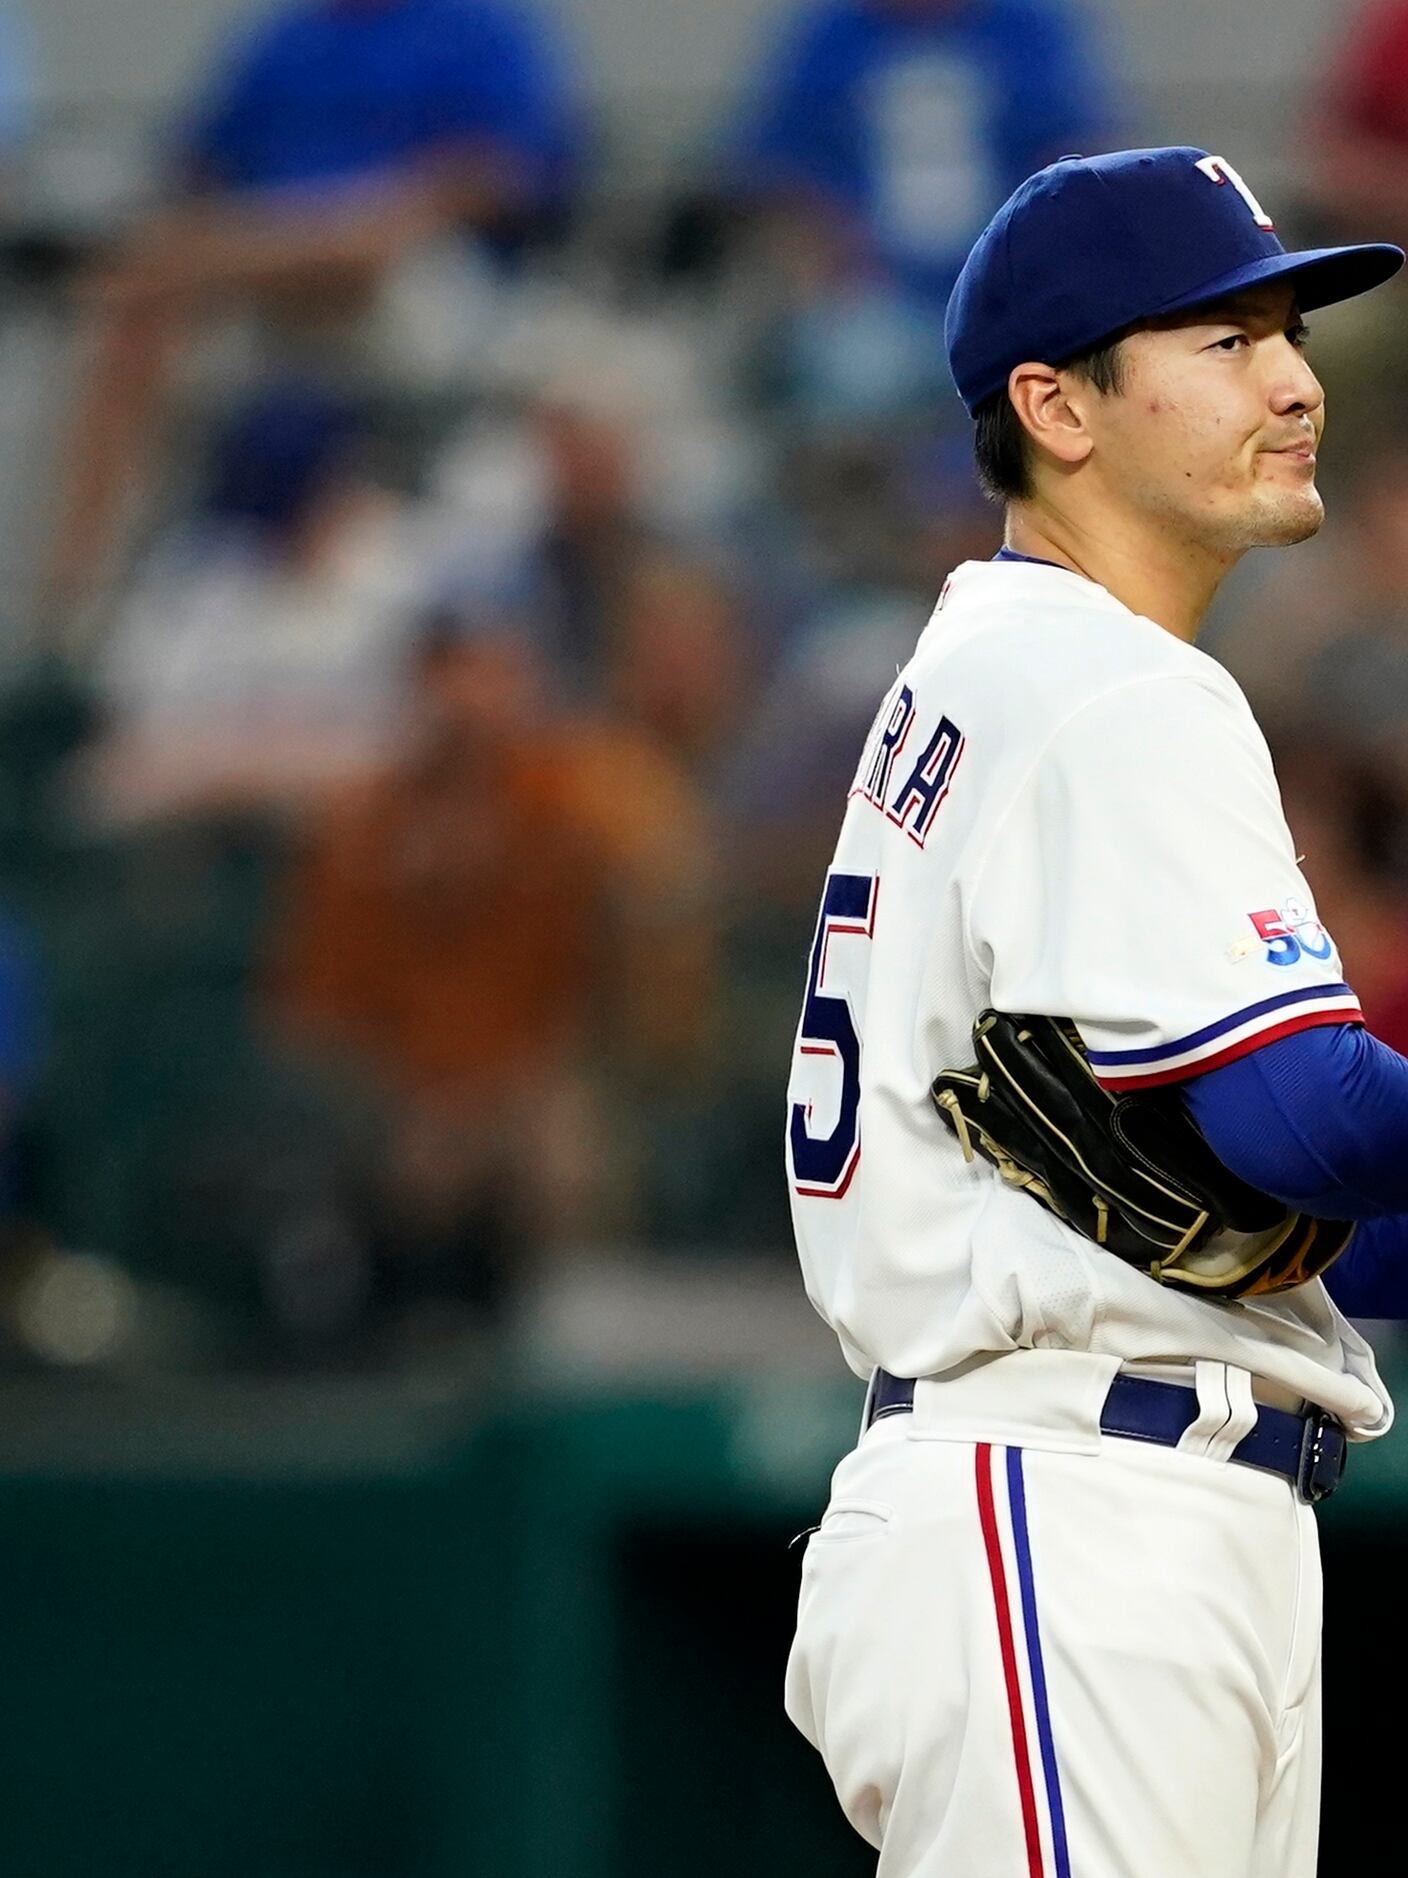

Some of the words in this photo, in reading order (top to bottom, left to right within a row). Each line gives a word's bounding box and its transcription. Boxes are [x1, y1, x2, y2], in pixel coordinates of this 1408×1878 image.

[1195, 156, 1275, 232] T
[848, 684, 965, 849] RA
[790, 873, 880, 1199] 5
